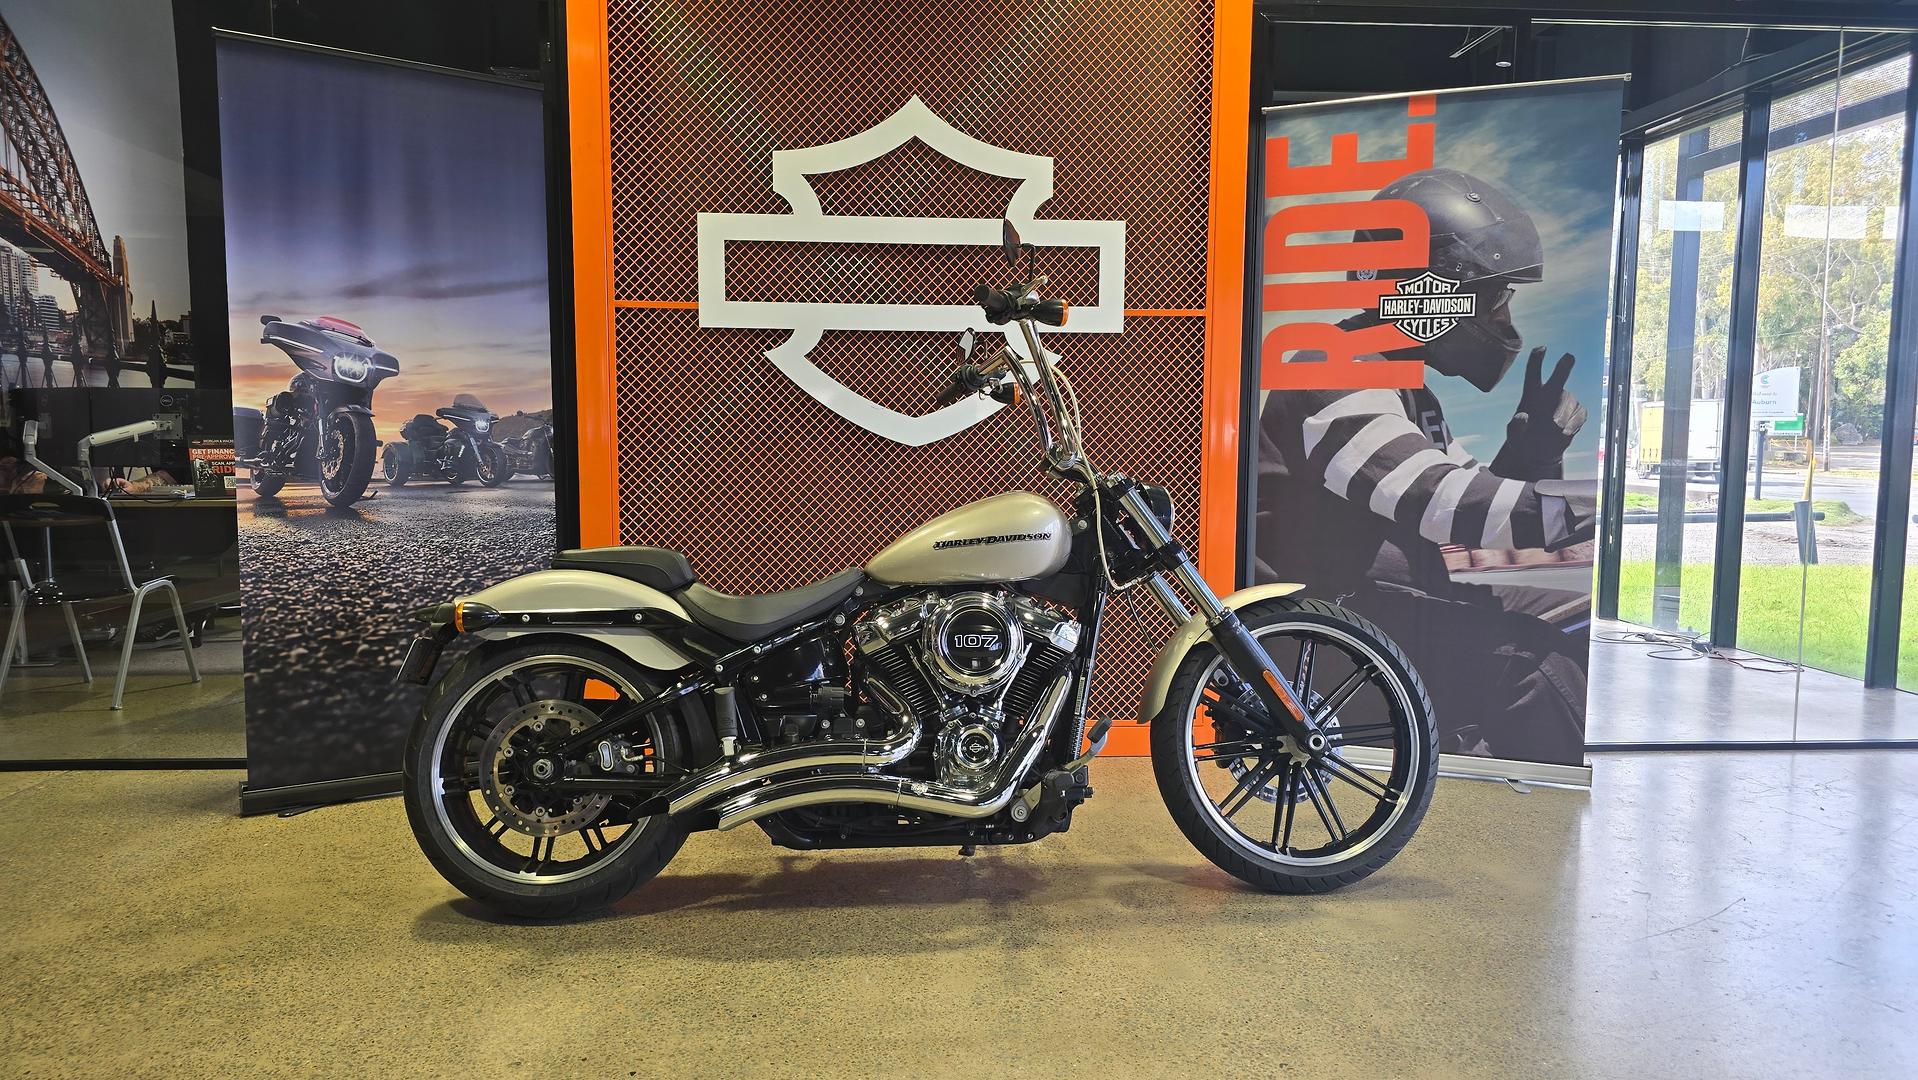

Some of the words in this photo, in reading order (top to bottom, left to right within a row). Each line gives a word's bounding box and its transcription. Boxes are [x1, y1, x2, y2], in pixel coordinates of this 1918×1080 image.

[1260, 94, 1436, 390] RIDE.
[1404, 276, 1451, 294] MOTOR
[1384, 297, 1472, 315] HARLEY-DAVIDSON
[1403, 318, 1450, 338] CYCLES
[933, 532, 1052, 550] HARLEY-DAVIDSON
[954, 634, 999, 648] 107
